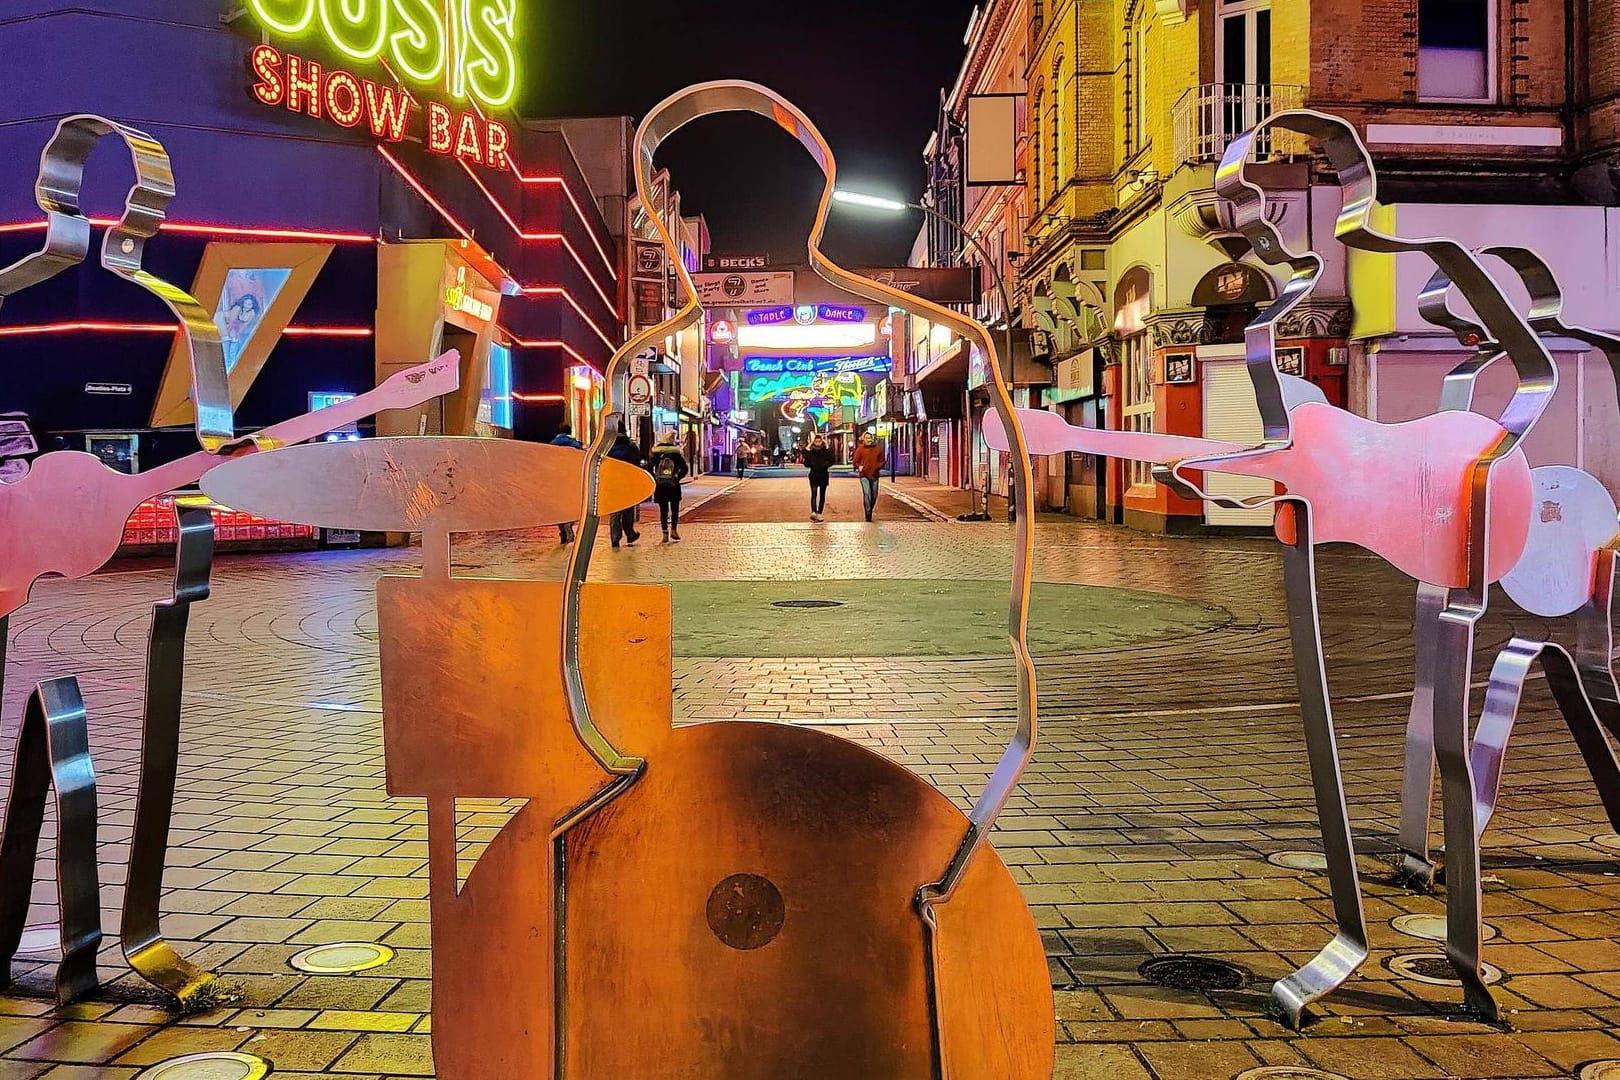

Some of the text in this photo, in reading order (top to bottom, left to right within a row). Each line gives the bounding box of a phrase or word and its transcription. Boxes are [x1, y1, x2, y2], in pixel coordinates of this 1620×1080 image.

[252, 44, 511, 171] SHOW BAR
[720, 256, 765, 267] BECK'S
[759, 308, 853, 322] TABLE DANCE
[747, 359, 814, 371] Beach Club
